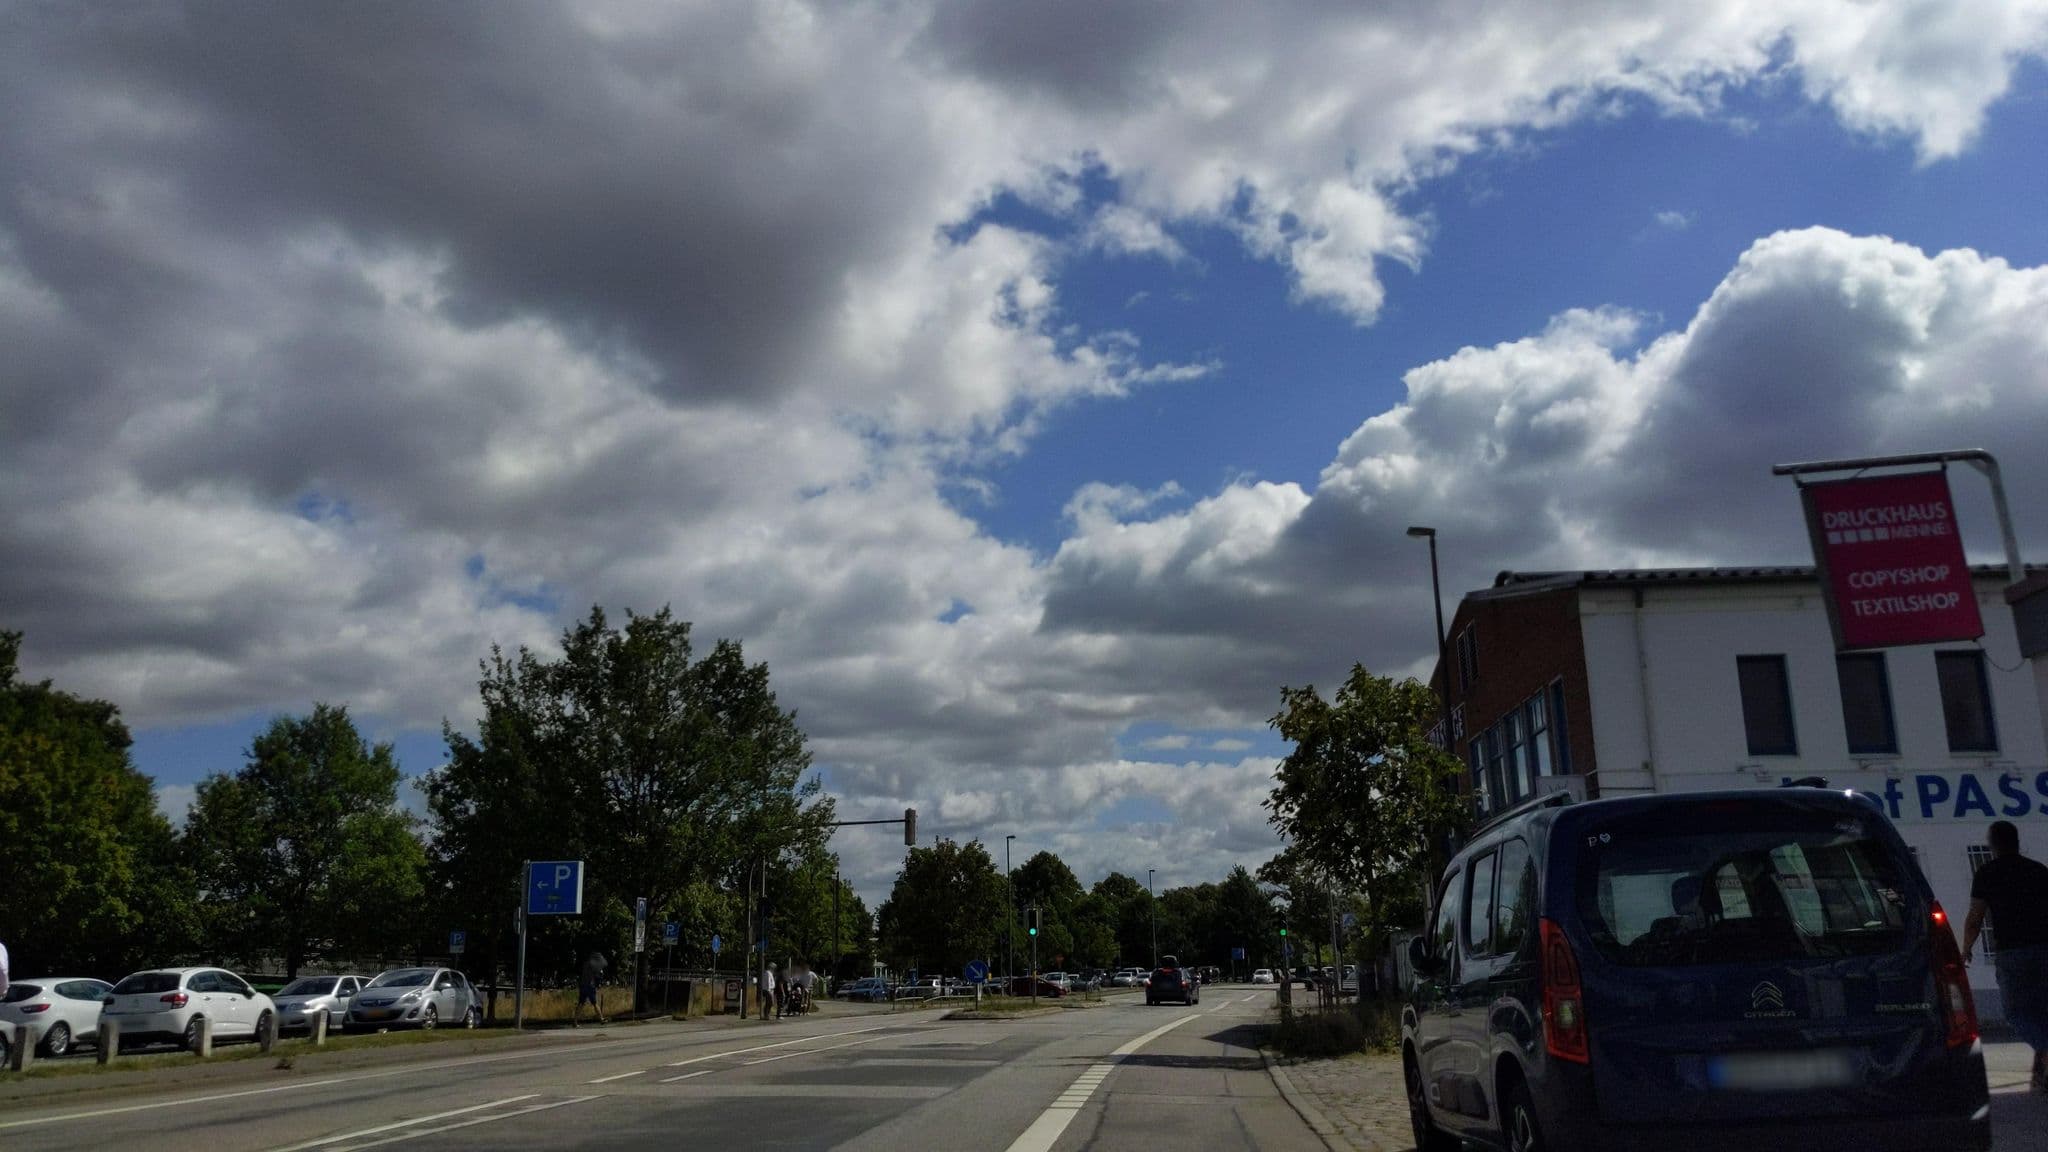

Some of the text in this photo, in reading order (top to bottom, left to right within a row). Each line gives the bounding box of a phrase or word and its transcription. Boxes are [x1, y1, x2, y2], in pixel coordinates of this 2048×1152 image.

[1823, 502, 1947, 529] DRUCKHAUS
[1891, 522, 1946, 539] MENNE
[1848, 565, 1949, 588] COPYSHOP
[1851, 592, 1960, 616] TEXTILSHOP
[554, 865, 571, 889] P
[666, 924, 675, 935] P
